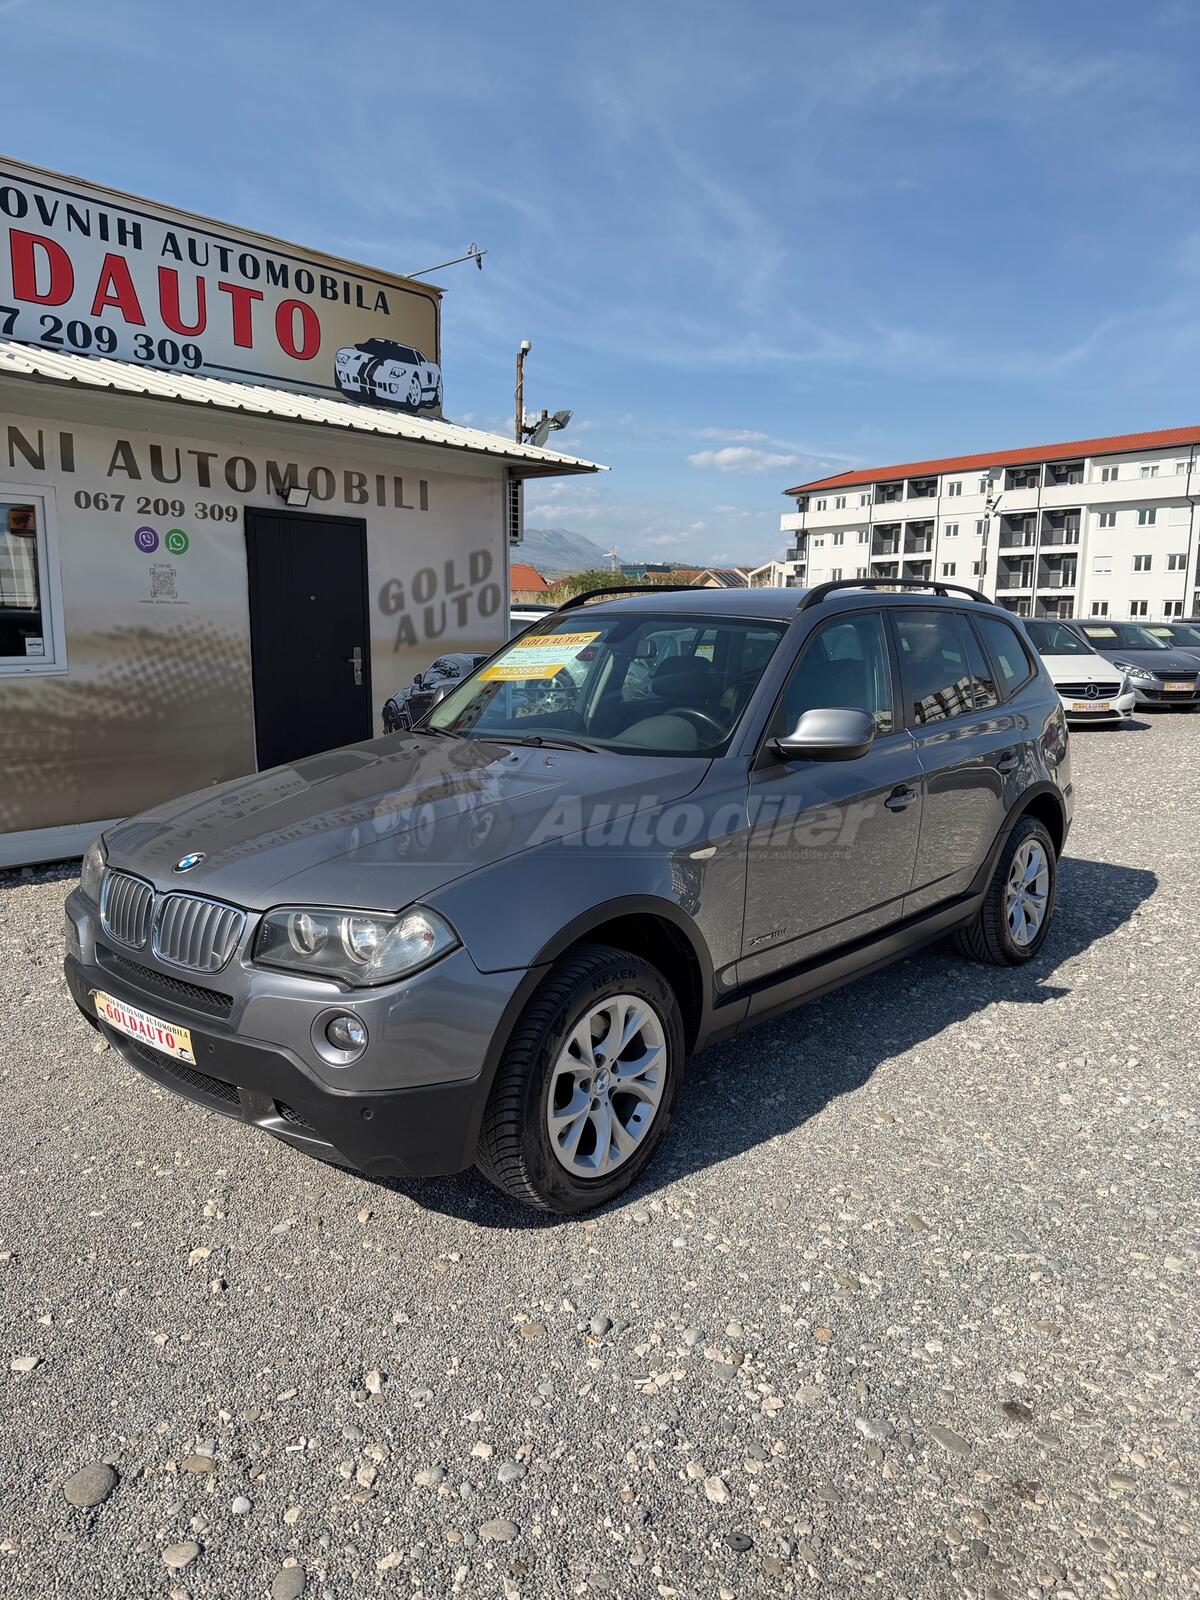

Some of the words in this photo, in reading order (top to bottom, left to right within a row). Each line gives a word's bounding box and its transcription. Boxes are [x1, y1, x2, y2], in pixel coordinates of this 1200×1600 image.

[0, 186, 143, 250] OVNIH
[161, 231, 390, 315] AUTOMOBILA
[9, 227, 321, 361] DAUTO
[0, 305, 20, 335] 7
[39, 314, 118, 354] 209
[133, 332, 203, 370] 309
[7, 425, 75, 473] NI
[107, 439, 429, 511] AUTOMOBILI
[74, 490, 125, 512] 067
[136, 496, 185, 517] 209
[194, 502, 238, 522] 309
[378, 549, 493, 616] GOLD
[393, 582, 501, 654] AUTO
[520, 637, 549, 646] GOLD
[550, 635, 580, 645] AUTO
[592, 968, 637, 992] NEXEN
[106, 1003, 175, 1049] GOLDAUTO
